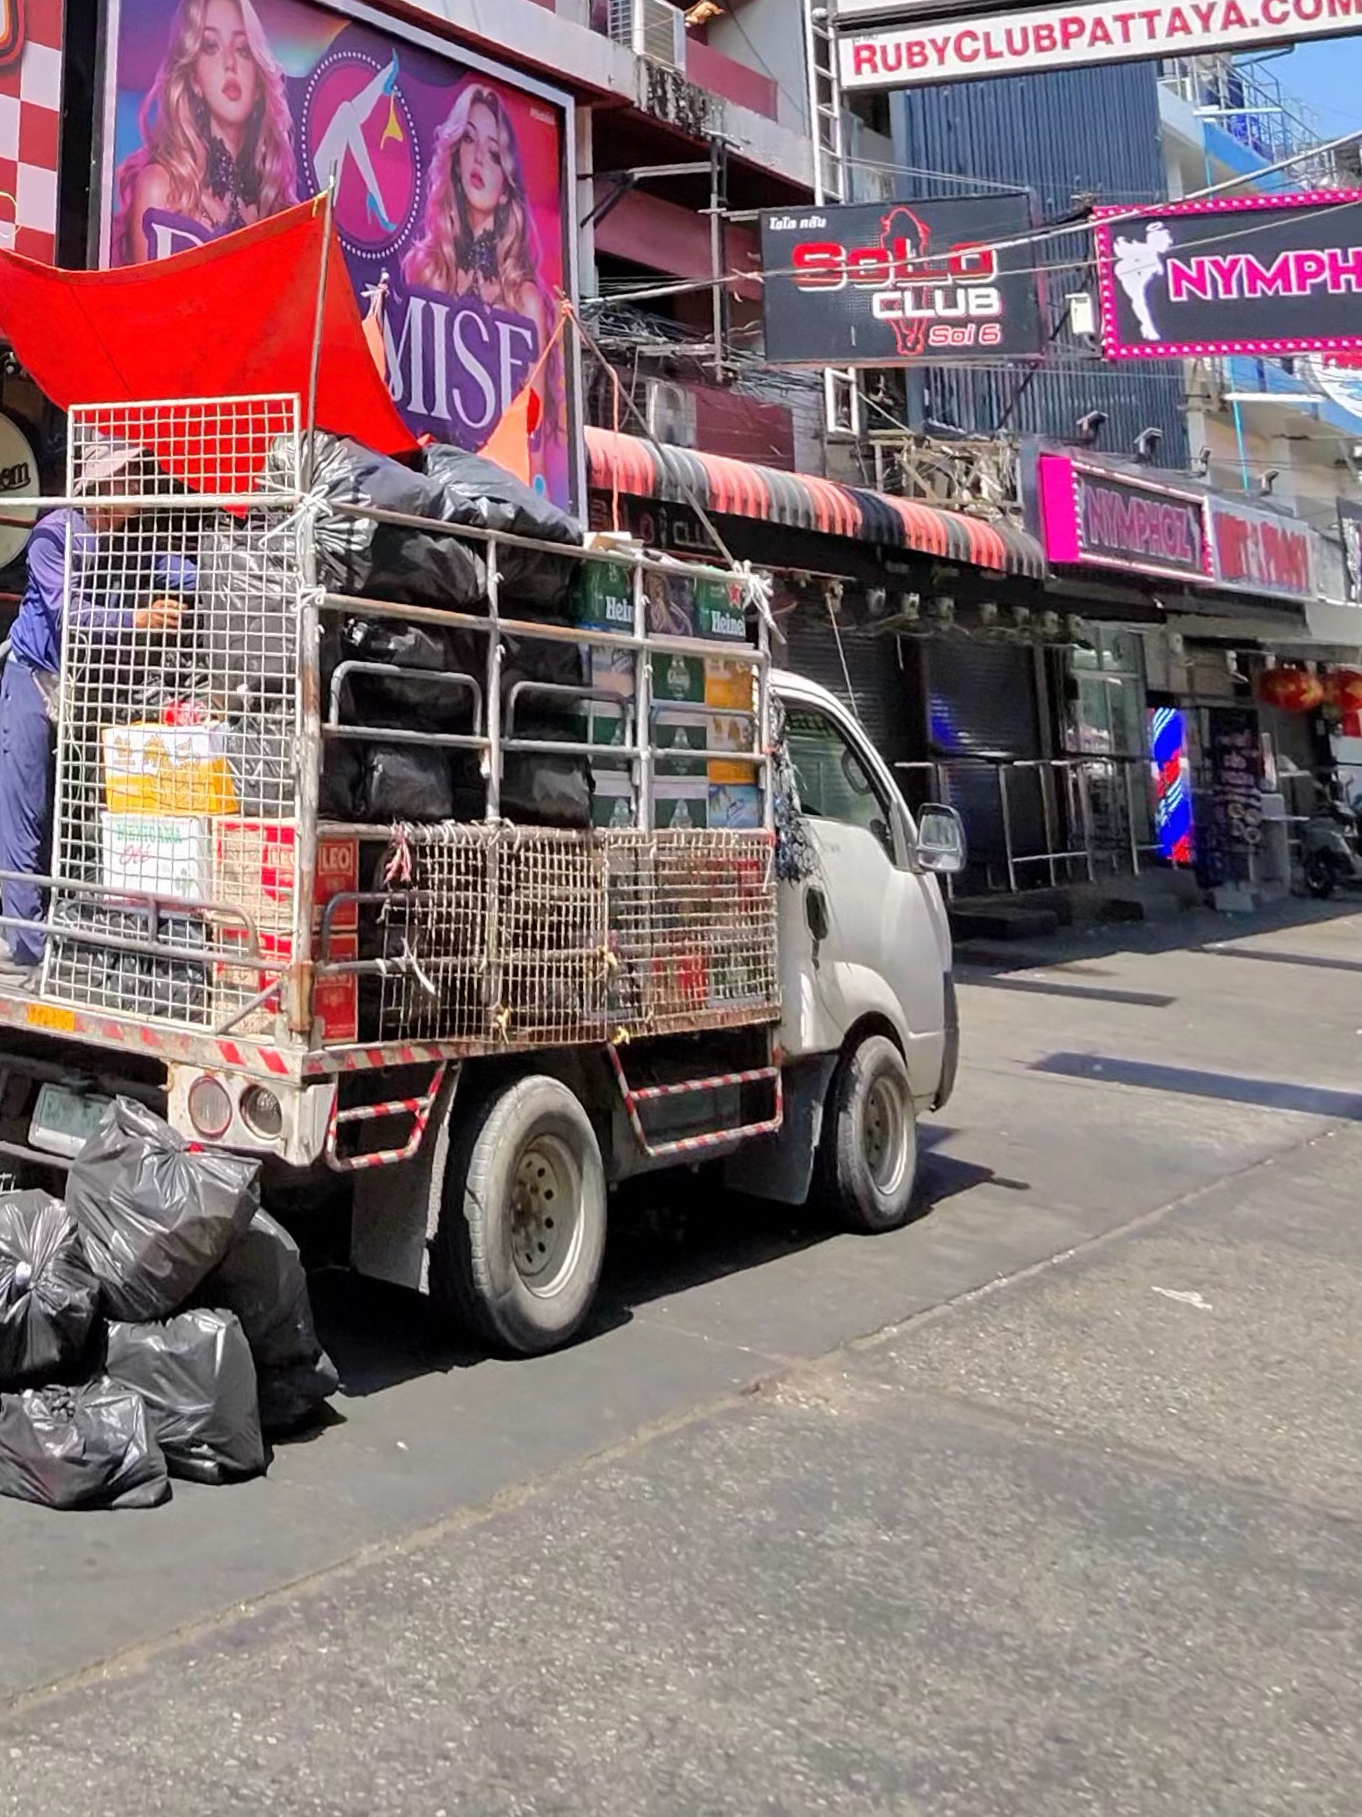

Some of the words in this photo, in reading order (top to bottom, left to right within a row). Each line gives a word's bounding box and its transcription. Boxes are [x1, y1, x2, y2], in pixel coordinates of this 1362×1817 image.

[871, 286, 1002, 319] CLUB
[979, 322, 1001, 345] 6
[321, 847, 351, 869] LEO
